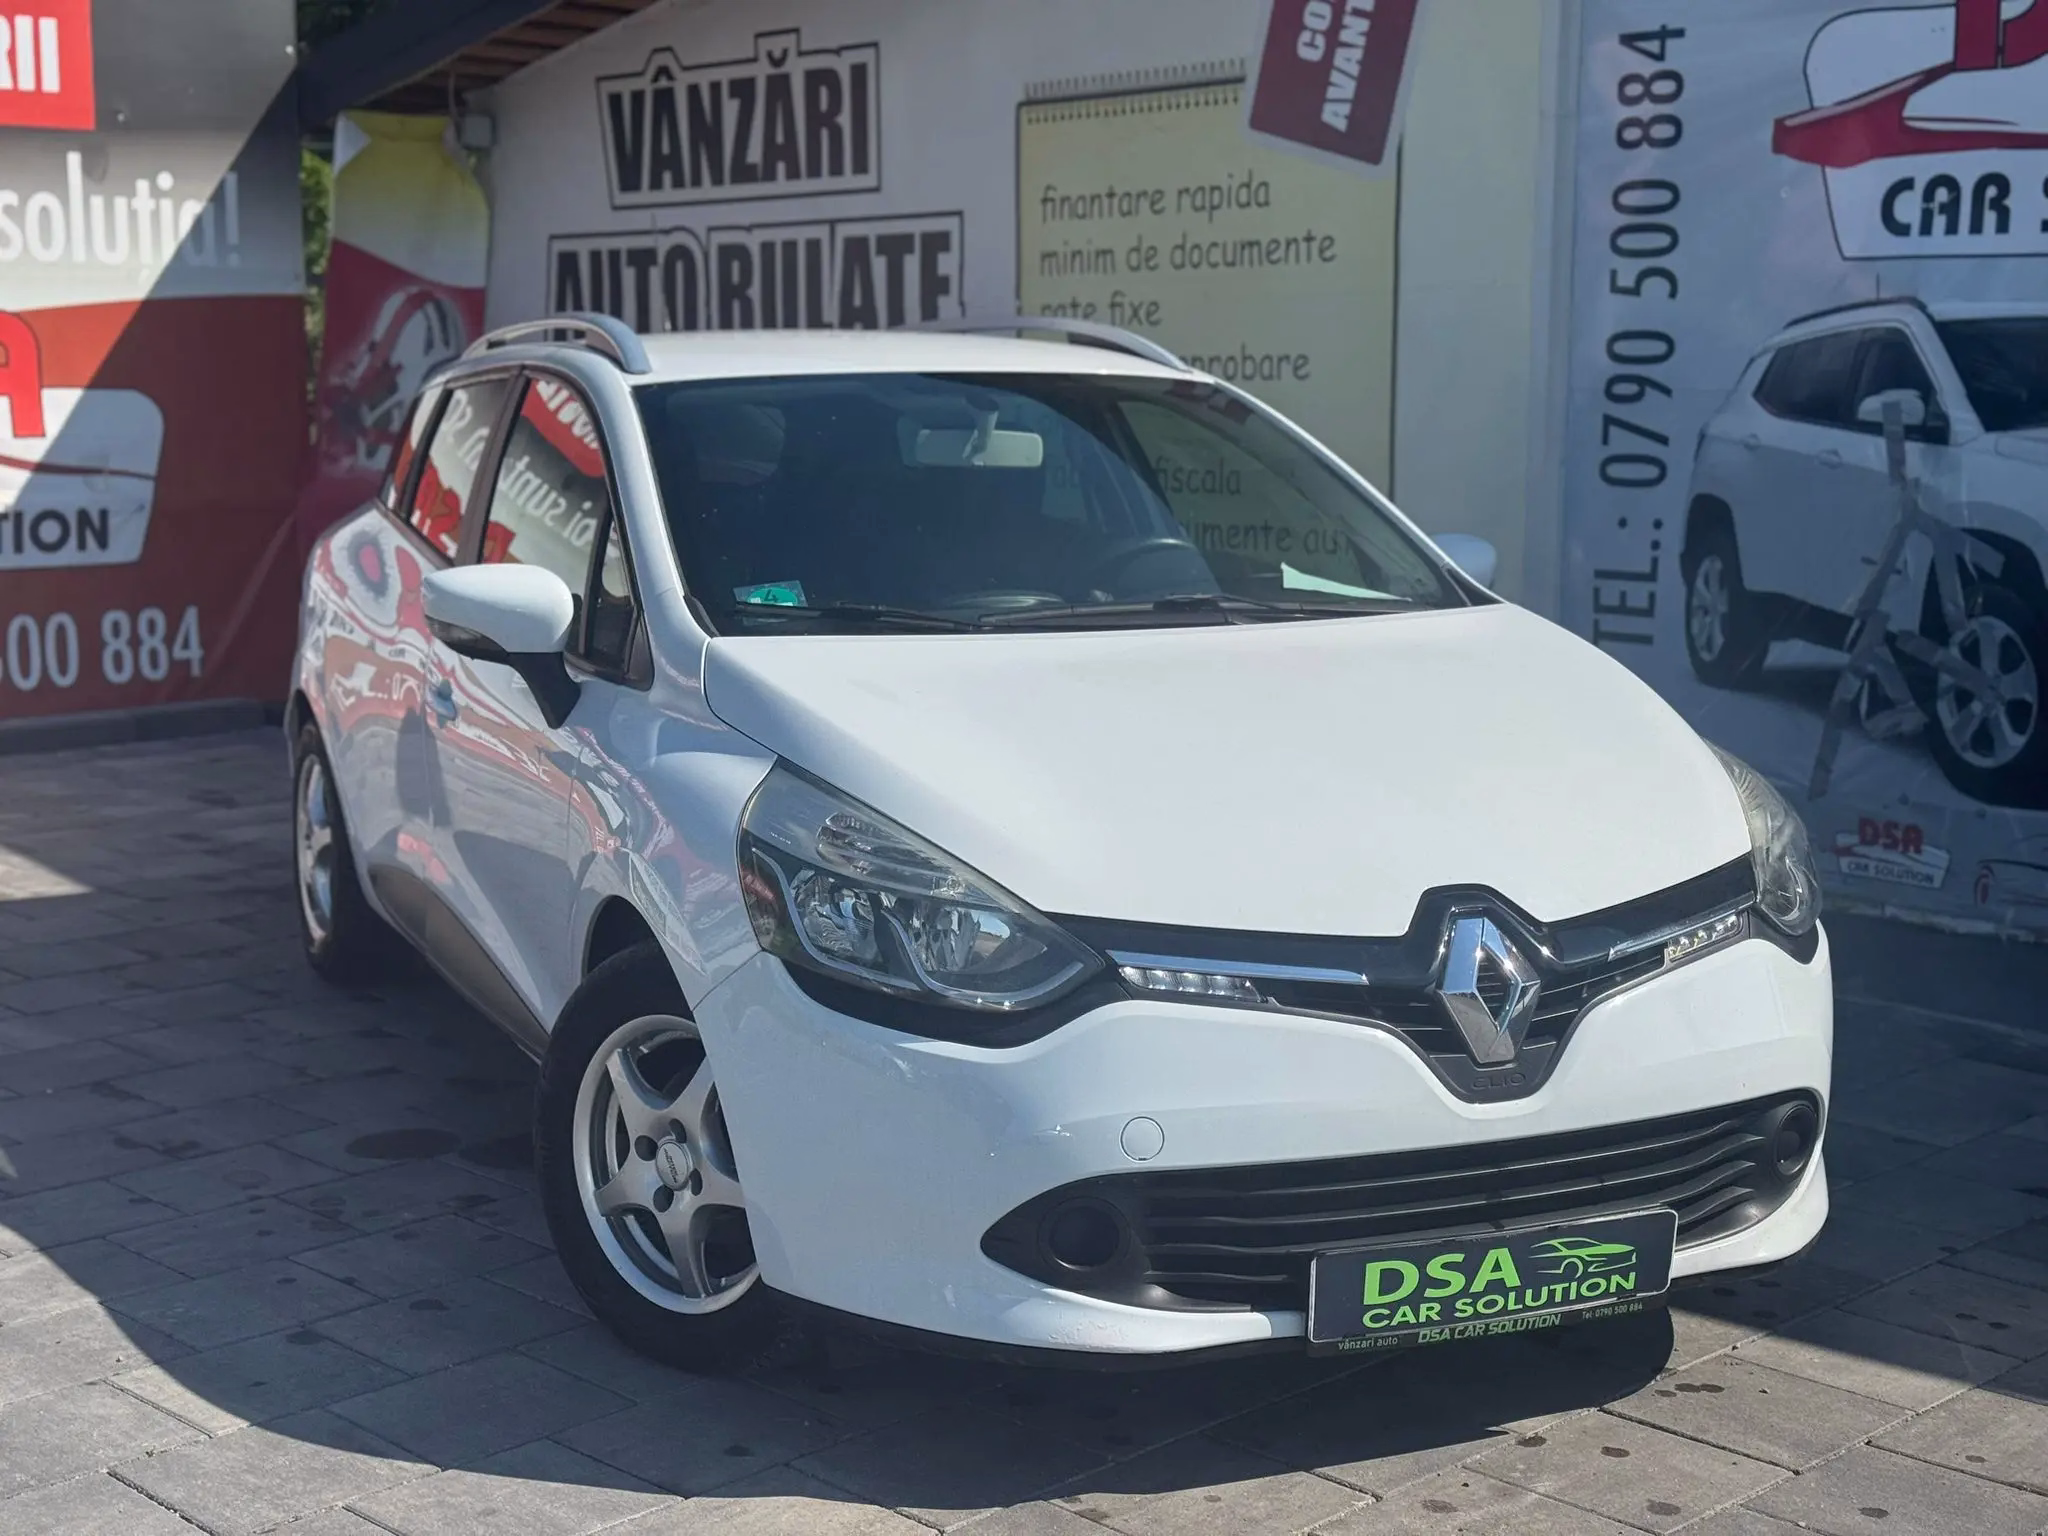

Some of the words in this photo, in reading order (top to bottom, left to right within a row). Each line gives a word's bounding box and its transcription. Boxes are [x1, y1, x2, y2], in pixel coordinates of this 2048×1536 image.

[1616, 24, 1687, 151] 884
[606, 46, 869, 194] VÂNZĂRI
[1040, 184, 1167, 224] finantare
[1175, 170, 1272, 223] rapida
[1880, 172, 2012, 237] CAR
[1039, 239, 1117, 277] minim
[1125, 233, 1160, 273] de
[1169, 228, 1338, 271] documente
[1608, 178, 1681, 301] 500
[1107, 289, 1163, 327] fixe
[1599, 330, 1676, 488] 0790
[0, 611, 79, 692] 00
[101, 604, 204, 684] 884
[1858, 816, 1925, 855] DSA
[1471, 1072, 1527, 1090] CLIO
[1362, 1247, 1522, 1306] DSA
[1362, 1302, 1441, 1329] CAR
[1453, 1271, 1637, 1318] SOLUTION
[1377, 1336, 1399, 1347] auto
[1417, 1328, 1451, 1344] DSA
[1454, 1323, 1485, 1340] CAR
[1487, 1313, 1562, 1336] SOLUTION
